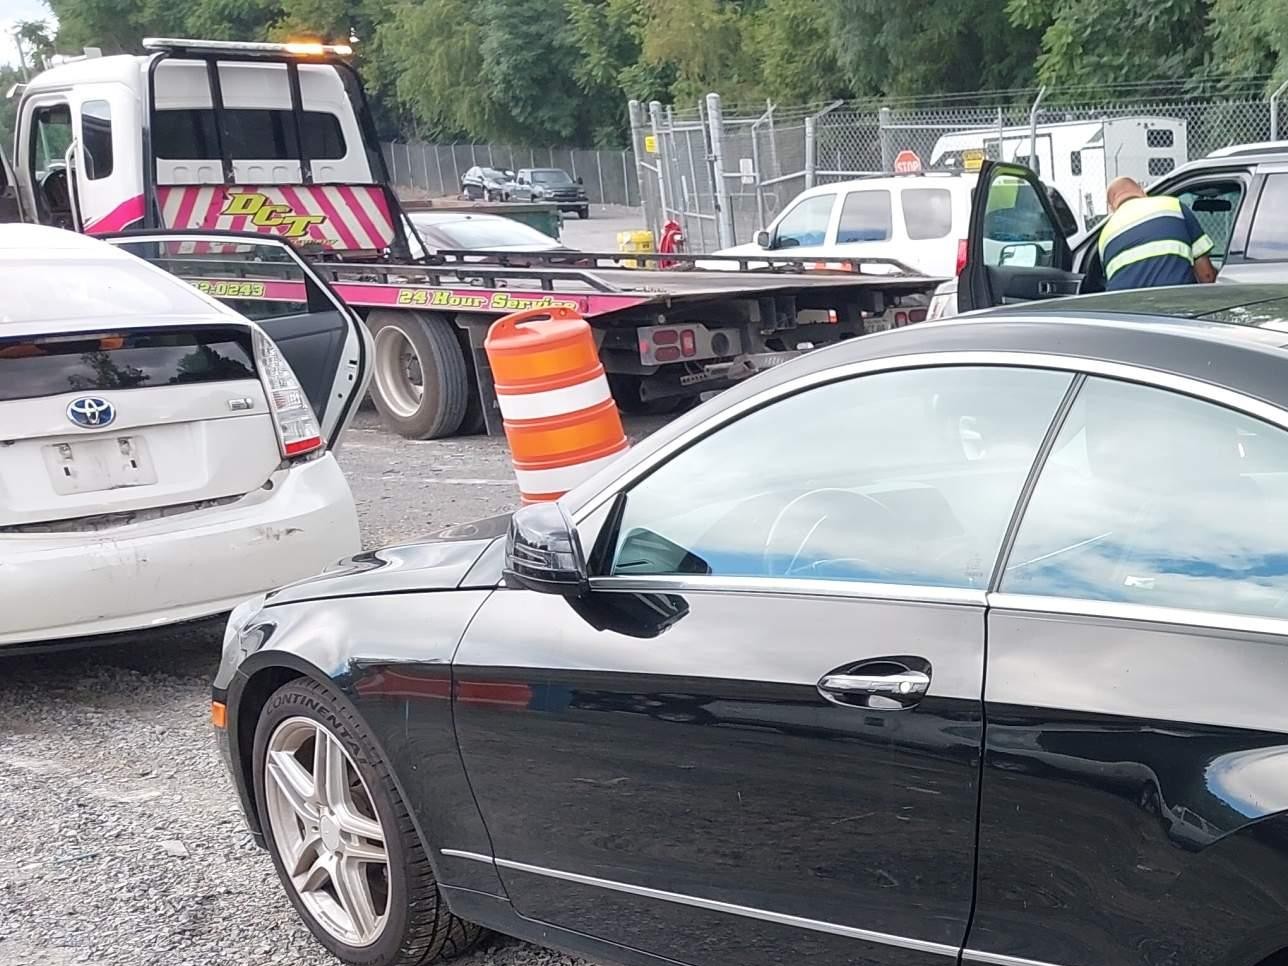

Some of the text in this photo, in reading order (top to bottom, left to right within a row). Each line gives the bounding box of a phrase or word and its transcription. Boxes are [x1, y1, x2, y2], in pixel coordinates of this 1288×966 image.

[897, 160, 919, 172] STOP
[220, 193, 328, 238] DCT
[399, 290, 428, 305] 24
[433, 290, 486, 307] Hour
[266, 693, 373, 765] CONTINENTAL
